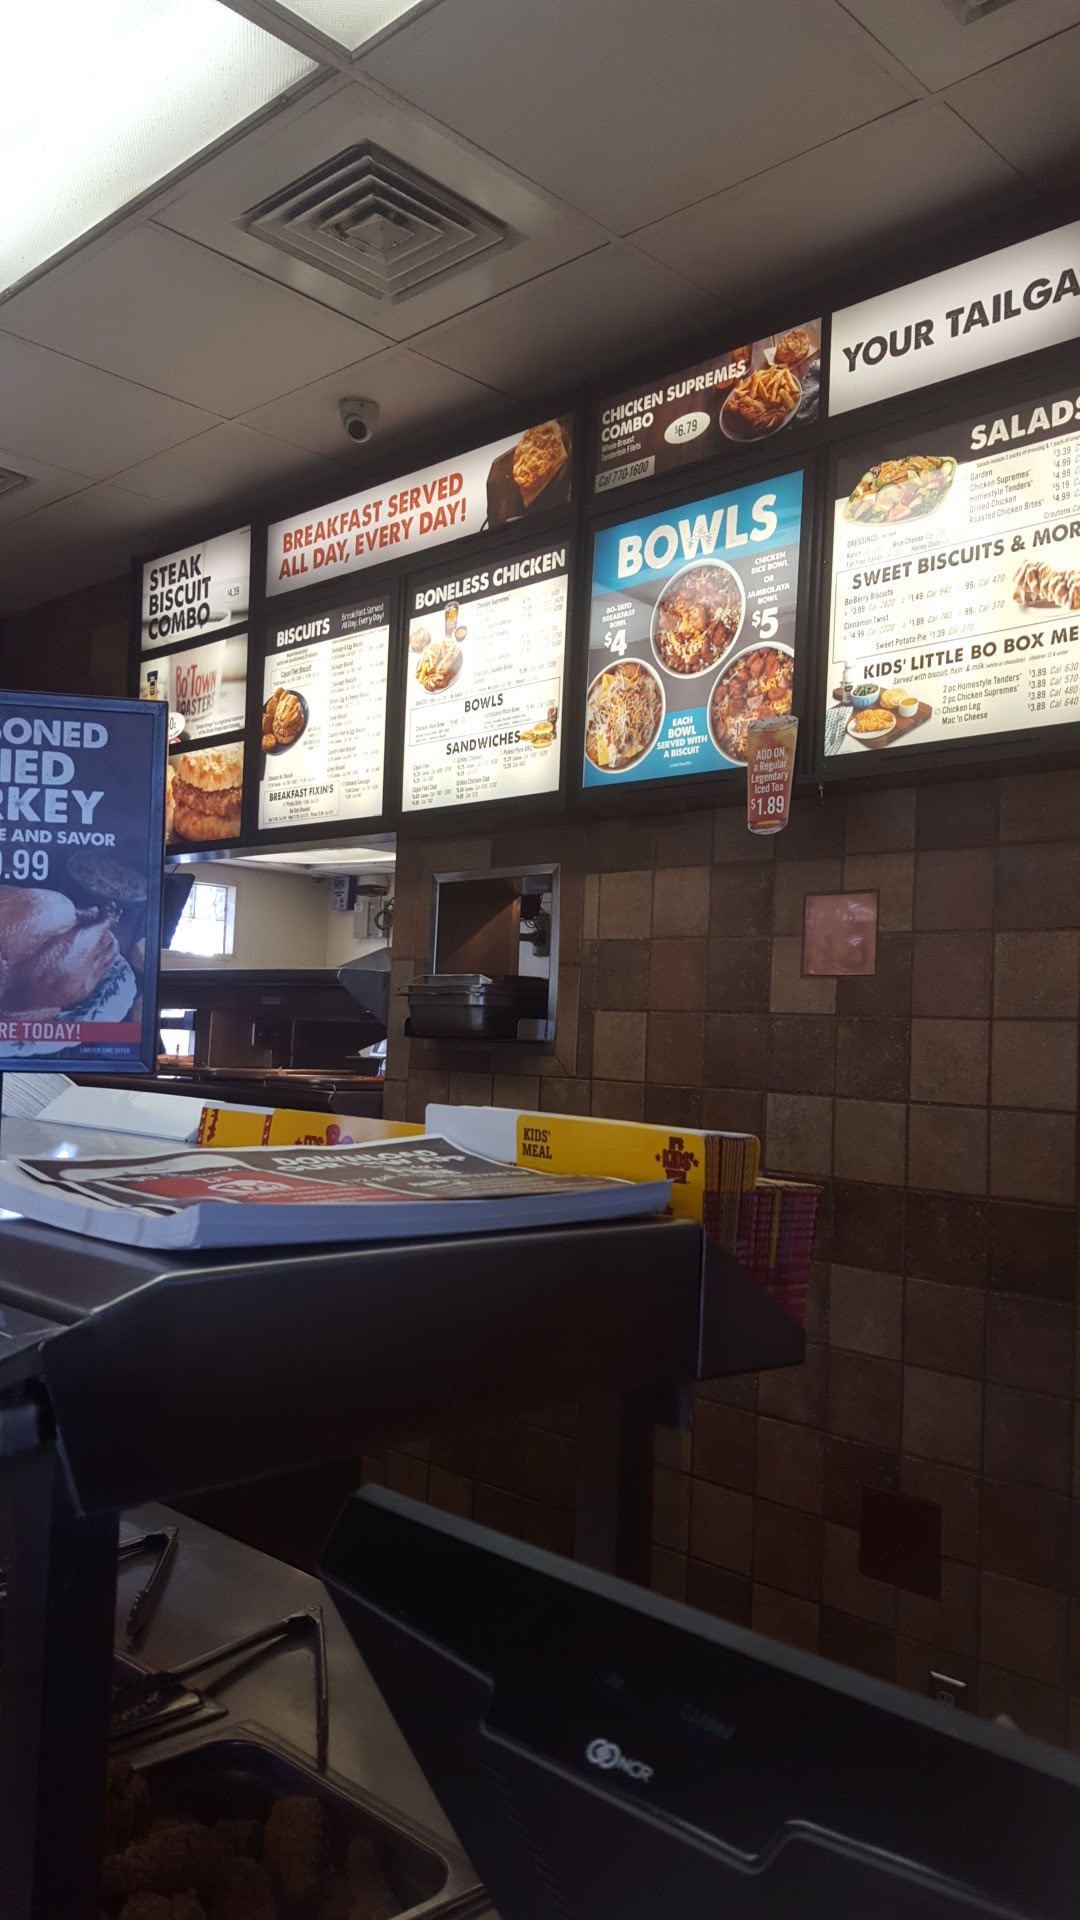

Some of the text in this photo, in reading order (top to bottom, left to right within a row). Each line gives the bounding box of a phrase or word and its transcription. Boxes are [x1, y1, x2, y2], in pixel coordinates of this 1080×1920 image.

[842, 318, 935, 373] YOUR
[601, 359, 747, 426] CHICKEN SUPREMES
[601, 412, 654, 443] COMBO
[675, 419, 698, 437] $6.79
[599, 461, 649, 488] Cal 770-1600
[969, 480, 996, 492] Chicken
[1053, 457, 1071, 468] $4.99
[970, 446, 1071, 481] Garden $3.39
[969, 487, 1004, 503] Homestyle
[1053, 469, 1071, 479] $4.99
[969, 481, 1070, 514] Grilled Chicken $5.19
[283, 472, 464, 553] BREAKFAST SERVED
[969, 511, 996, 524] Roasted
[997, 504, 1023, 517] Chicken
[1052, 491, 1071, 502] $4.99
[1043, 508, 1071, 519] Croutons
[279, 498, 467, 580] ALL DAY, EVERY DAY!
[617, 493, 778, 579] BOWLS
[751, 559, 789, 575] RICE BOWL
[755, 551, 786, 566] CHICKEN
[852, 561, 913, 590] SWEET
[917, 538, 1005, 575] BISCUITS
[1010, 535, 1026, 552] &
[150, 553, 201, 591] STEAK
[415, 549, 566, 610] BONELESS CHICKEN
[763, 574, 775, 583] OR
[149, 576, 211, 616] BISCUIT
[747, 583, 790, 598] JAMBOLAYA
[757, 595, 779, 605] BOWL
[870, 589, 894, 600] Biscuits
[341, 603, 384, 621] Breakfast Served
[602, 610, 636, 623] BREAKFAST
[606, 602, 632, 614] BO-TATO
[149, 602, 210, 640] COMBO
[277, 618, 330, 647] BISCUITS
[609, 619, 627, 629] BOWL
[752, 607, 779, 639] $5
[843, 614, 889, 630] Cinnamon Twist
[604, 629, 628, 656] $4
[876, 629, 945, 650] Sweet Potato Pie $1.39
[864, 625, 1079, 680] KIDS' LITTLE BO BOX ME
[893, 675, 913, 686] Served
[914, 671, 927, 681] with
[971, 662, 984, 671] milk
[942, 684, 948, 693] 2
[948, 683, 956, 693] pc
[957, 678, 992, 692] Homestyle
[1028, 668, 1047, 678] $3.89
[1050, 665, 1062, 675] Cal
[1064, 662, 1079, 672] 630
[942, 695, 948, 704] 2
[948, 694, 956, 704] pc
[956, 689, 983, 702] Chicken
[1028, 680, 1046, 689] $3.89
[1049, 677, 1062, 687] Cal
[1064, 673, 1079, 683] 570
[942, 685, 1079, 715] Chicken Leg $3.89 Cal 480
[464, 693, 504, 713] BOWLS
[941, 714, 956, 725] Mac
[964, 711, 988, 722] Cheese
[1027, 702, 1046, 712] $3.89
[1049, 699, 1062, 709] Cal
[1064, 696, 1079, 706] 640
[668, 725, 697, 739] BOWL
[672, 715, 693, 726] EACH
[0, 717, 109, 749] ONED
[446, 730, 521, 756] SANDWICHES
[656, 735, 708, 750] SERVED WITH
[663, 746, 700, 759] A BISCUIT
[756, 747, 785, 761] ADD ON
[751, 771, 789, 785] Legendary
[759, 760, 787, 773] Regular
[269, 788, 307, 802] BREAKFAST
[309, 784, 334, 796] FIXIN'S
[754, 782, 784, 794] Iced Tea
[0, 786, 105, 825] KEY
[750, 796, 785, 816] $1.89
[11, 828, 116, 847] AND SAVOR
[0, 849, 49, 881] .99
[22, 1022, 81, 1040] TODAY!
[523, 1127, 551, 1143] KIDS'
[271, 1149, 439, 1167] DOWNLOAD
[522, 1143, 553, 1160] MEAL
[618, 1757, 655, 1783] NCR
